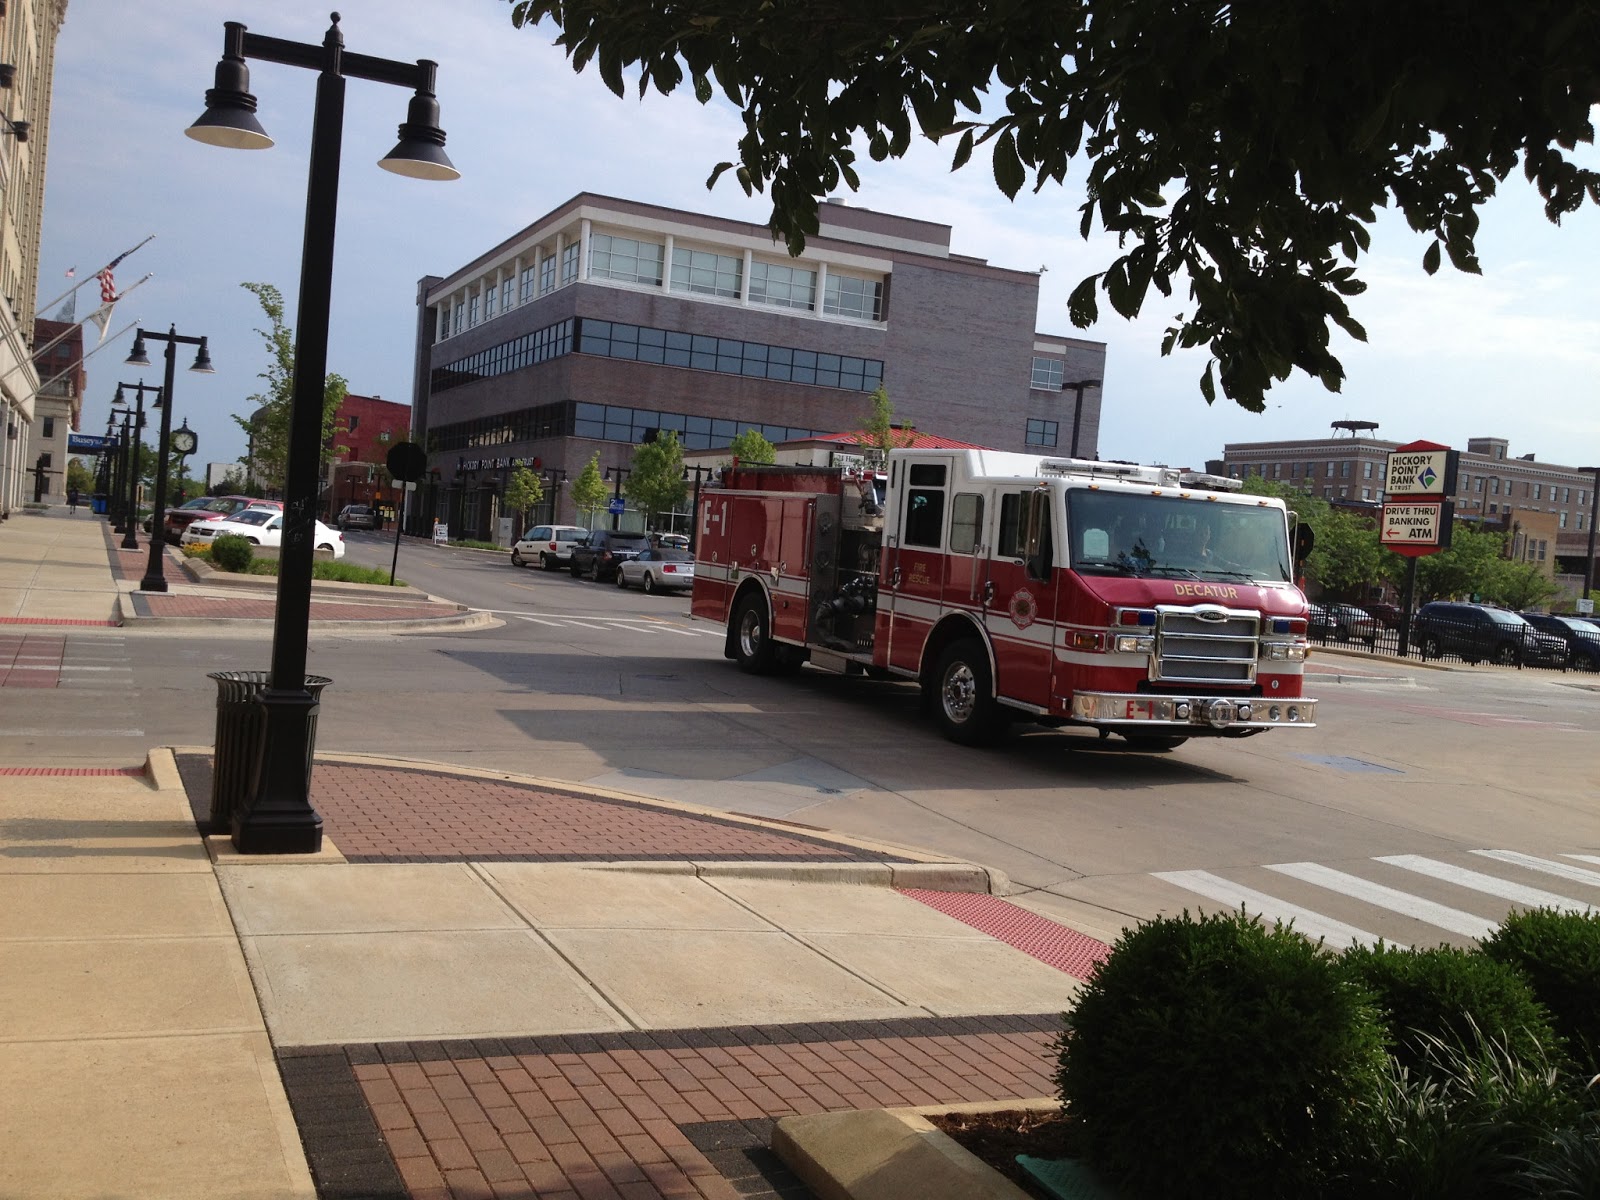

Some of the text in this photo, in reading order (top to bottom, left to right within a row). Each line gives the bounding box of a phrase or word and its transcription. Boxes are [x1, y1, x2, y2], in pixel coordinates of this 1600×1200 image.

[72, 435, 94, 446] Busey
[496, 457, 510, 469] BANK
[1392, 456, 1432, 465] HICKORY
[1391, 466, 1419, 475] POINT
[1390, 475, 1415, 484] BANK
[1385, 507, 1437, 516] DRIVE THRU
[702, 500, 728, 537] E-1
[1389, 517, 1431, 526] BANKING
[1408, 528, 1433, 539] ATM
[914, 562, 926, 573] FIRE
[908, 573, 930, 585] RESCUE
[1173, 583, 1239, 599] DECATUR
[1126, 700, 1154, 719] E-1
